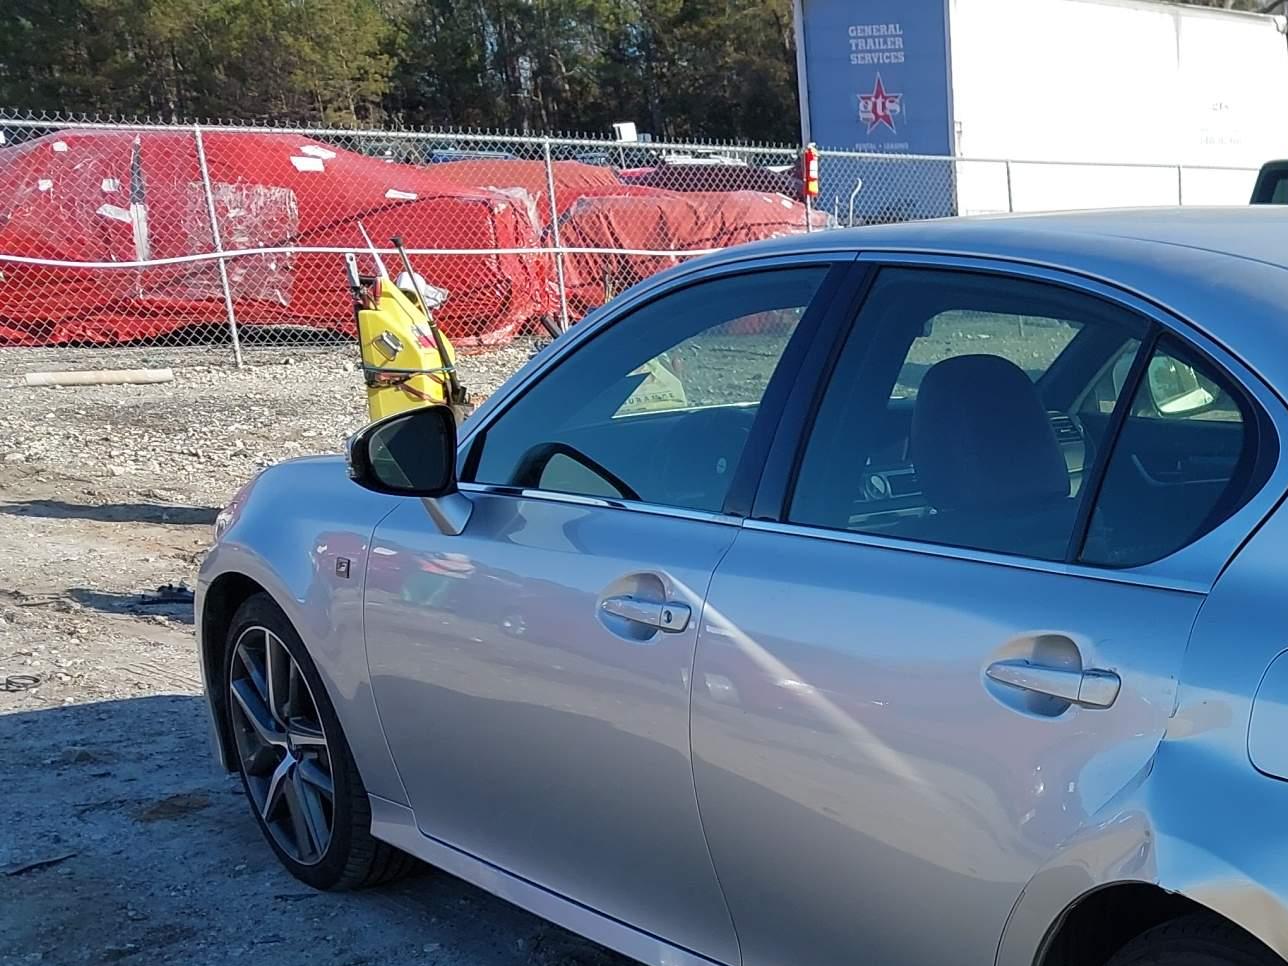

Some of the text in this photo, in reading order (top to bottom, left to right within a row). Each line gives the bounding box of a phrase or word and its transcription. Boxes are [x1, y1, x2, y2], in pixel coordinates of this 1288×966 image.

[848, 24, 903, 37] GENERAL
[849, 37, 904, 50] TRAILER
[849, 51, 905, 65] SERVICES
[859, 94, 901, 123] gts
